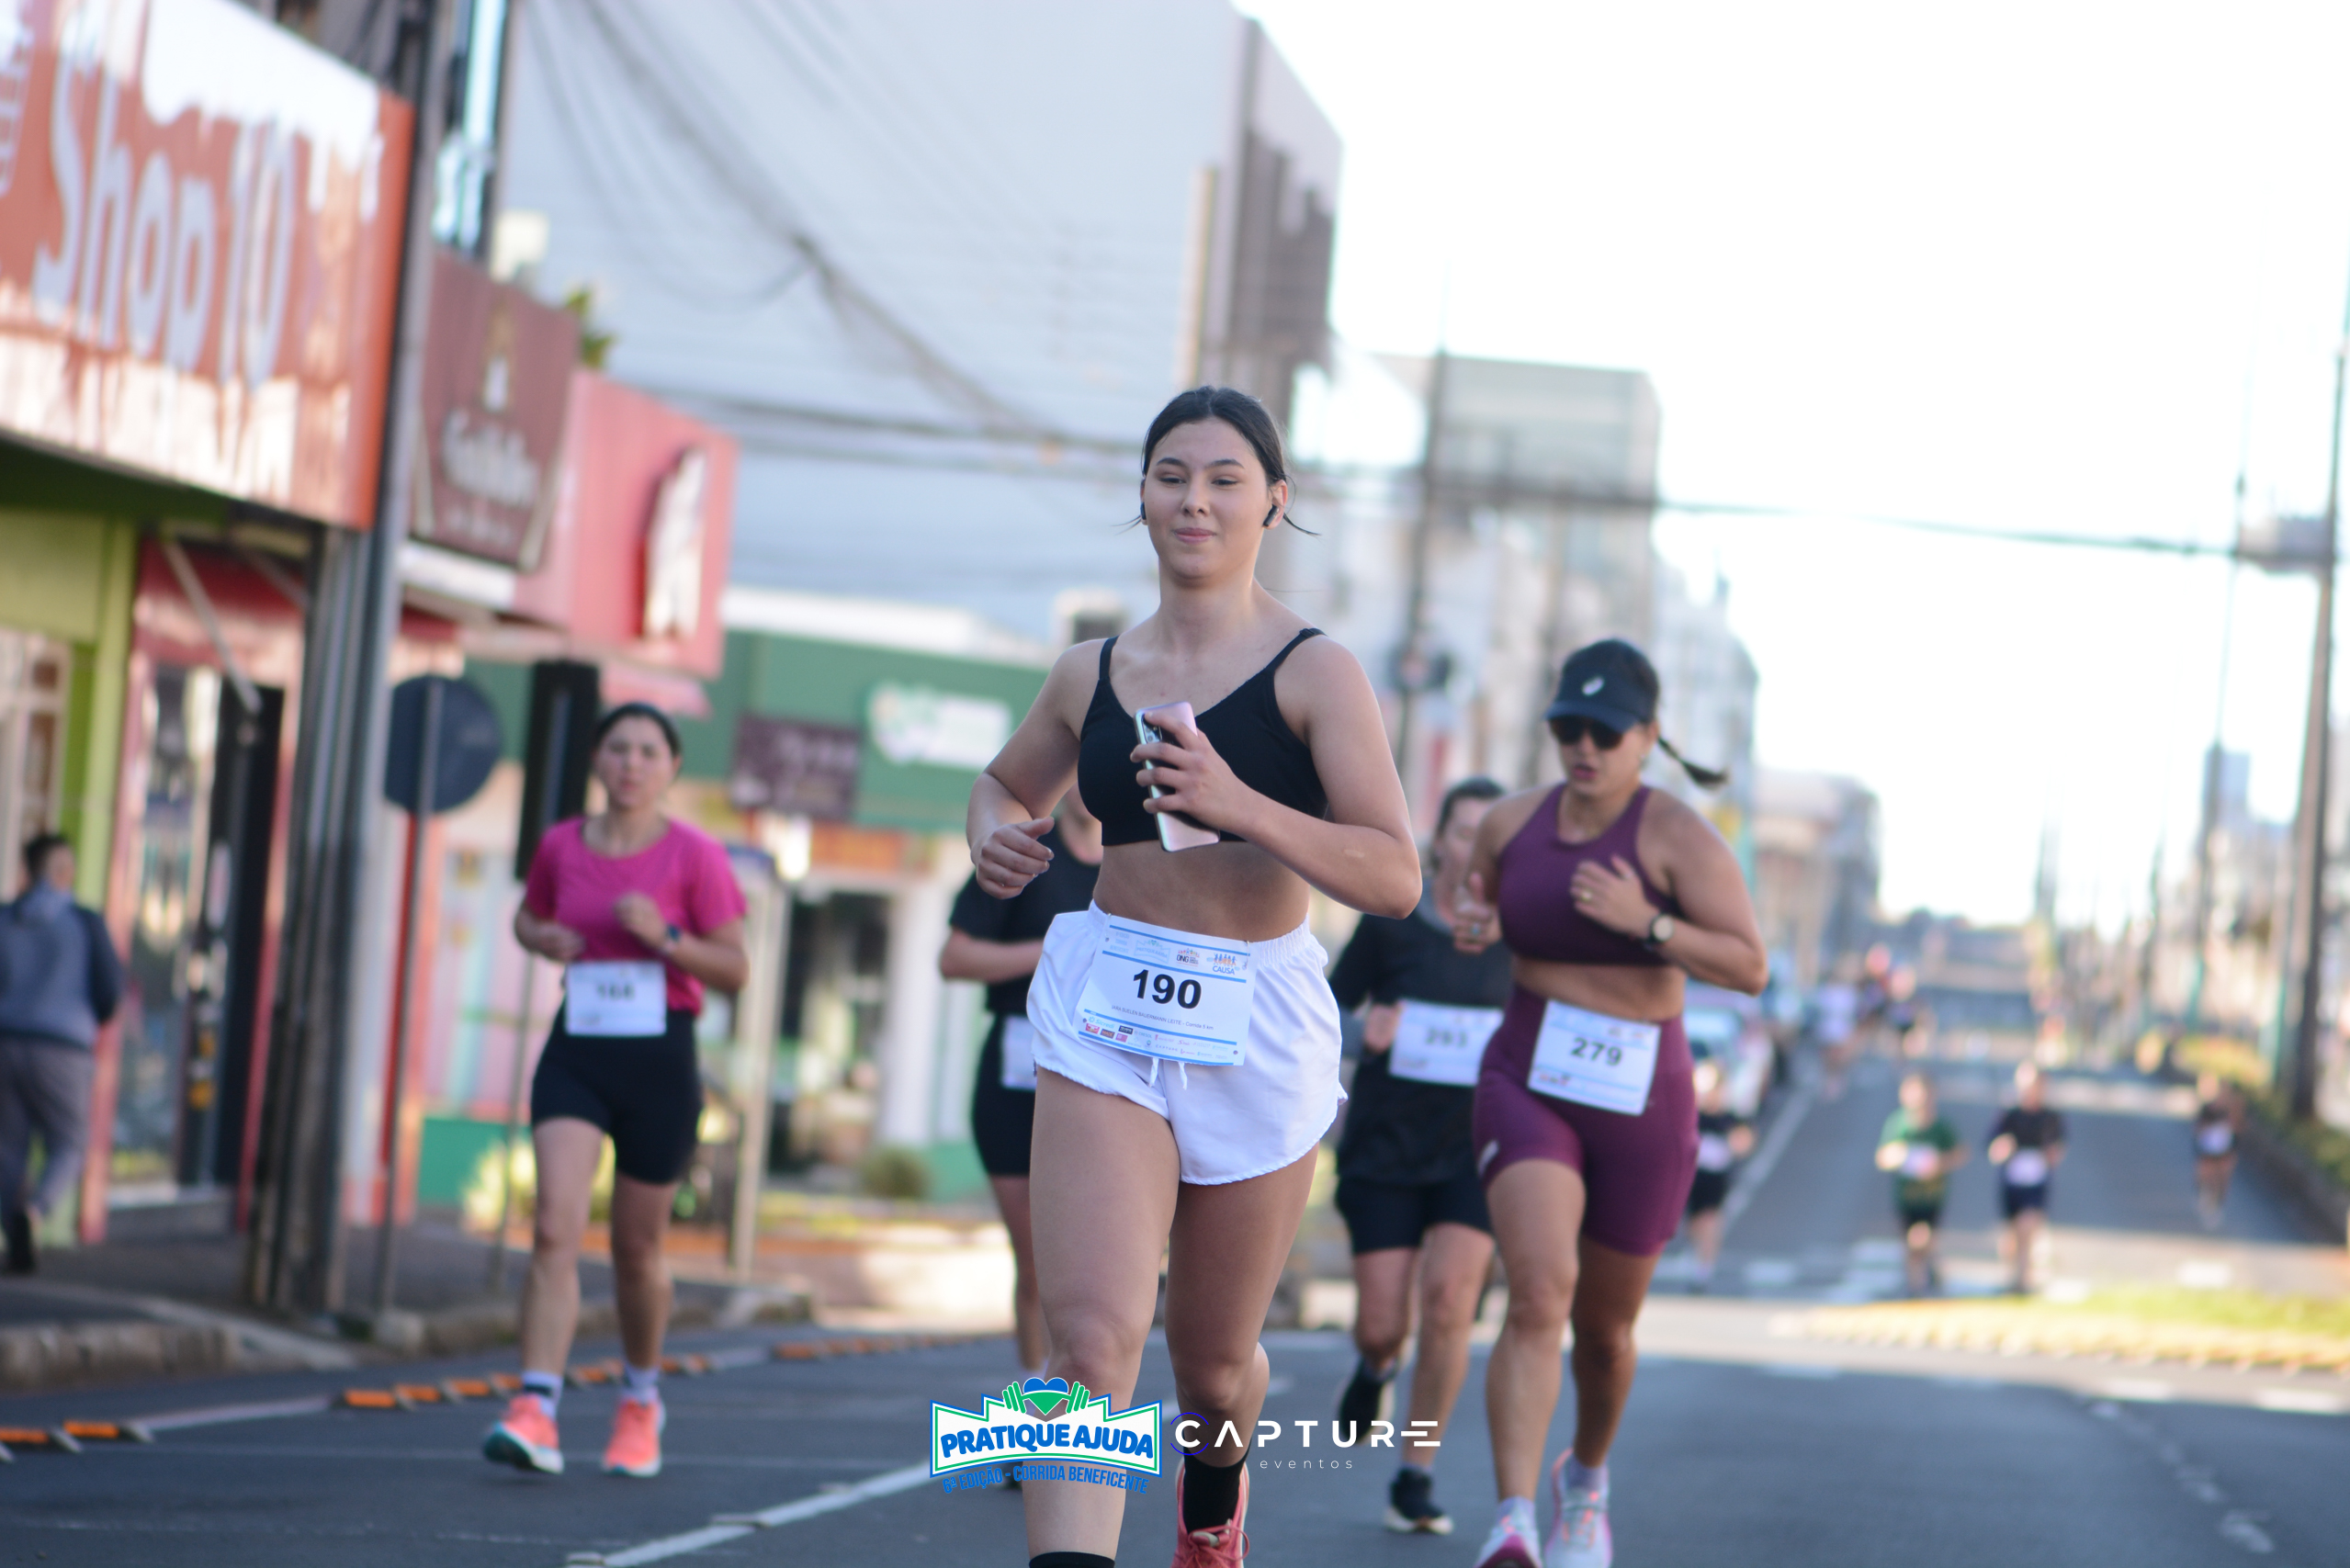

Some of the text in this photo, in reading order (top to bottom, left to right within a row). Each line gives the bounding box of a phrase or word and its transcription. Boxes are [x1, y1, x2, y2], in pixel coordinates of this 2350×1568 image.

[31, 6, 217, 374] Shop
[218, 114, 297, 393] 10
[1176, 953, 1190, 964] ONG
[1212, 964, 1236, 975] CAUSA
[1133, 968, 1202, 1010] 190
[1095, 1018, 1115, 1029] Sicredi
[1167, 1018, 1182, 1026] LEITE
[1570, 1036, 1623, 1066] 279
